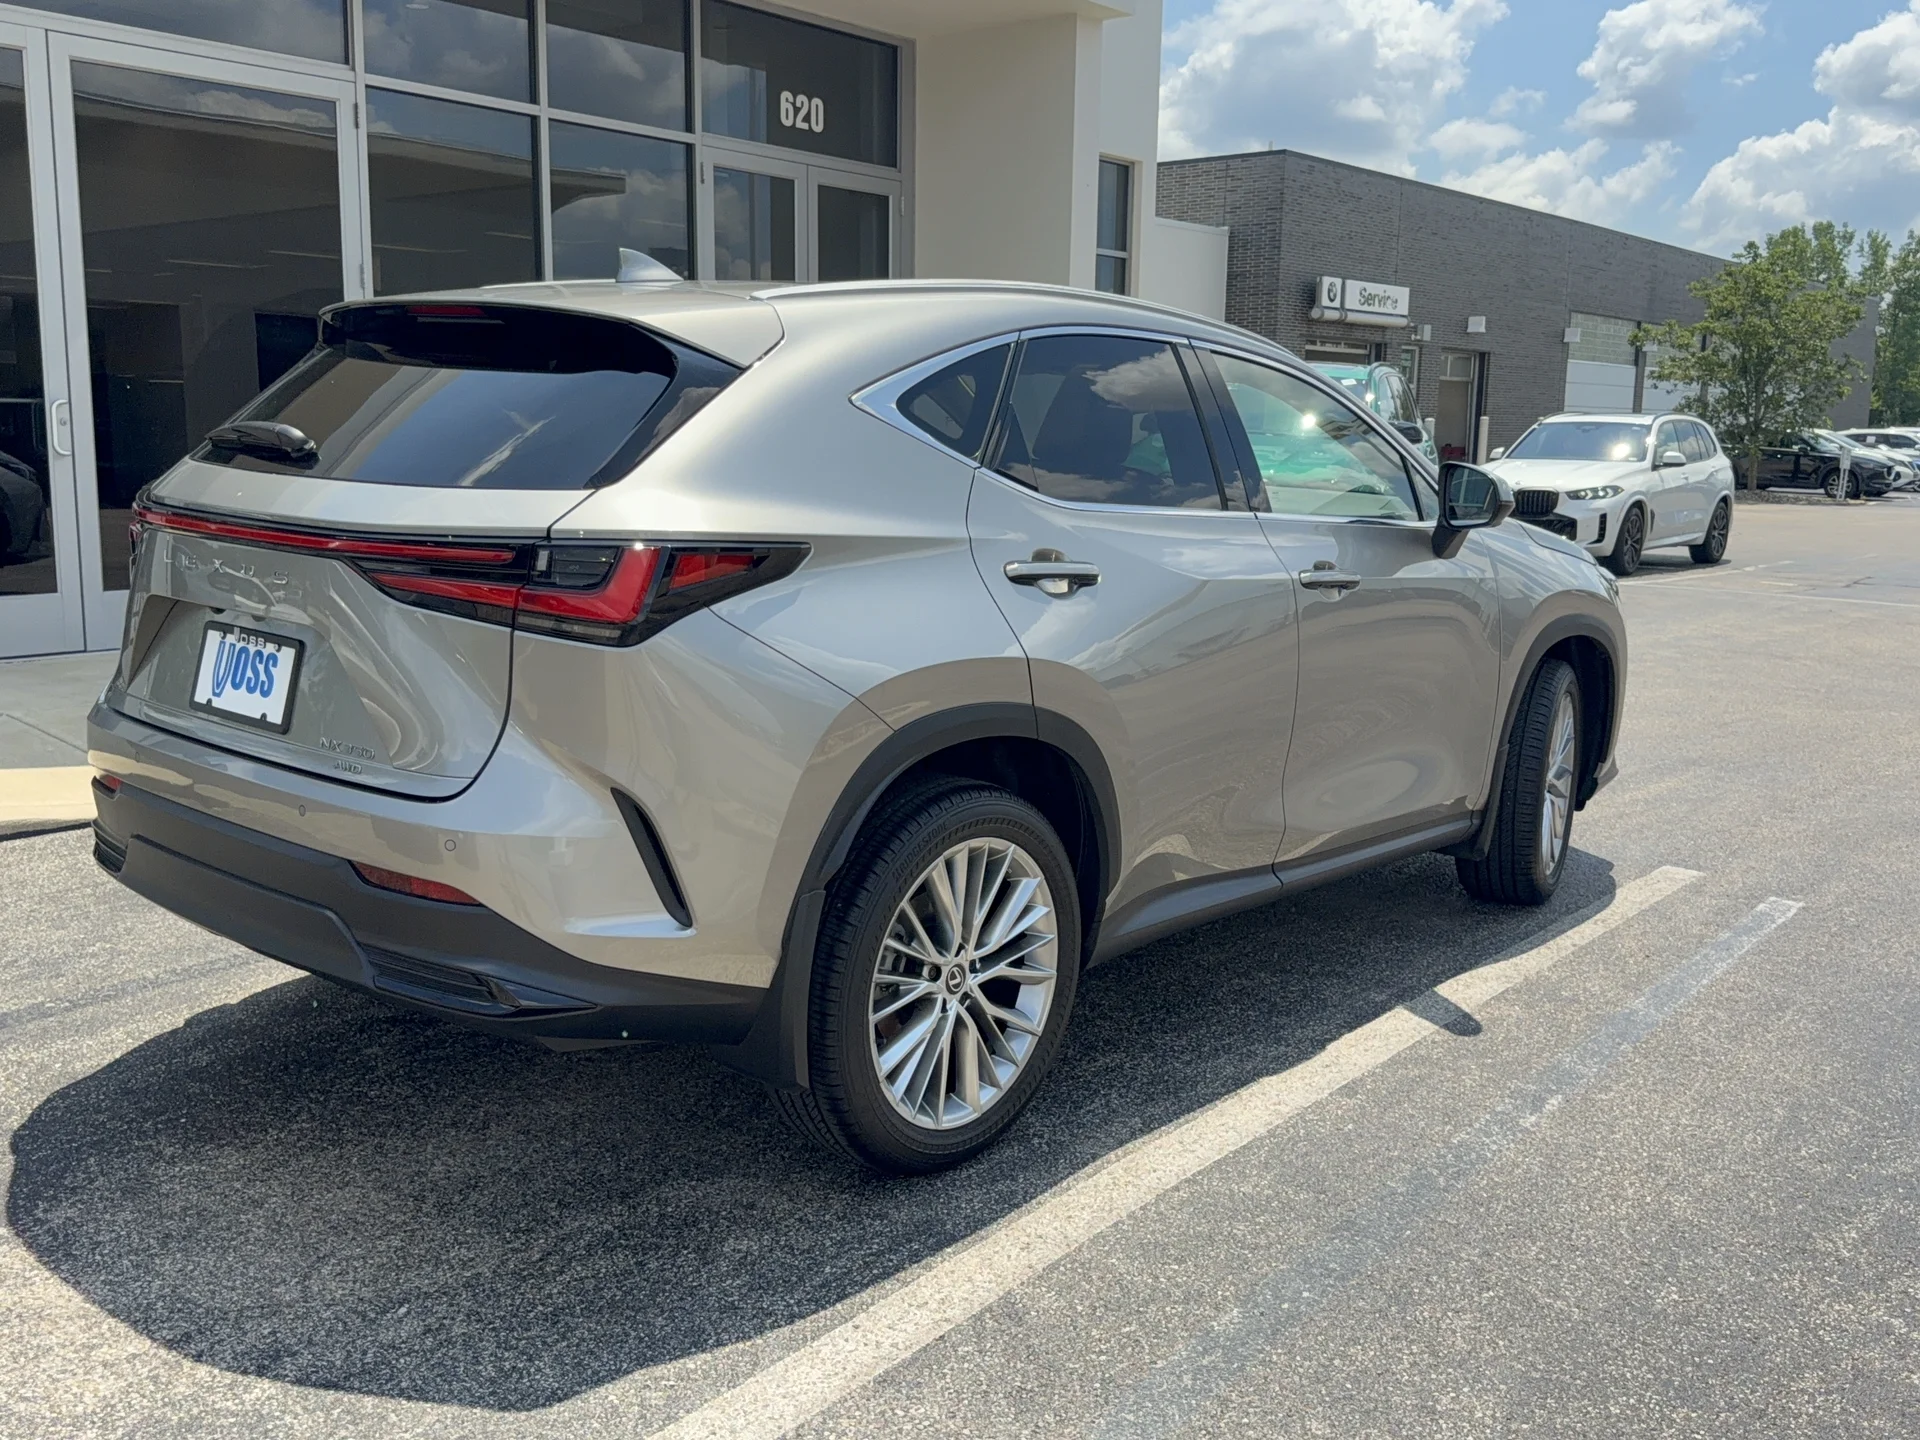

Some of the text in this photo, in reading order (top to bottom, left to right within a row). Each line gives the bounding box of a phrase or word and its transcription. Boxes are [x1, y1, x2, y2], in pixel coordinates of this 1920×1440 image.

[780, 90, 824, 133] 620
[1358, 286, 1398, 310] Service
[212, 640, 279, 698] VOSS
